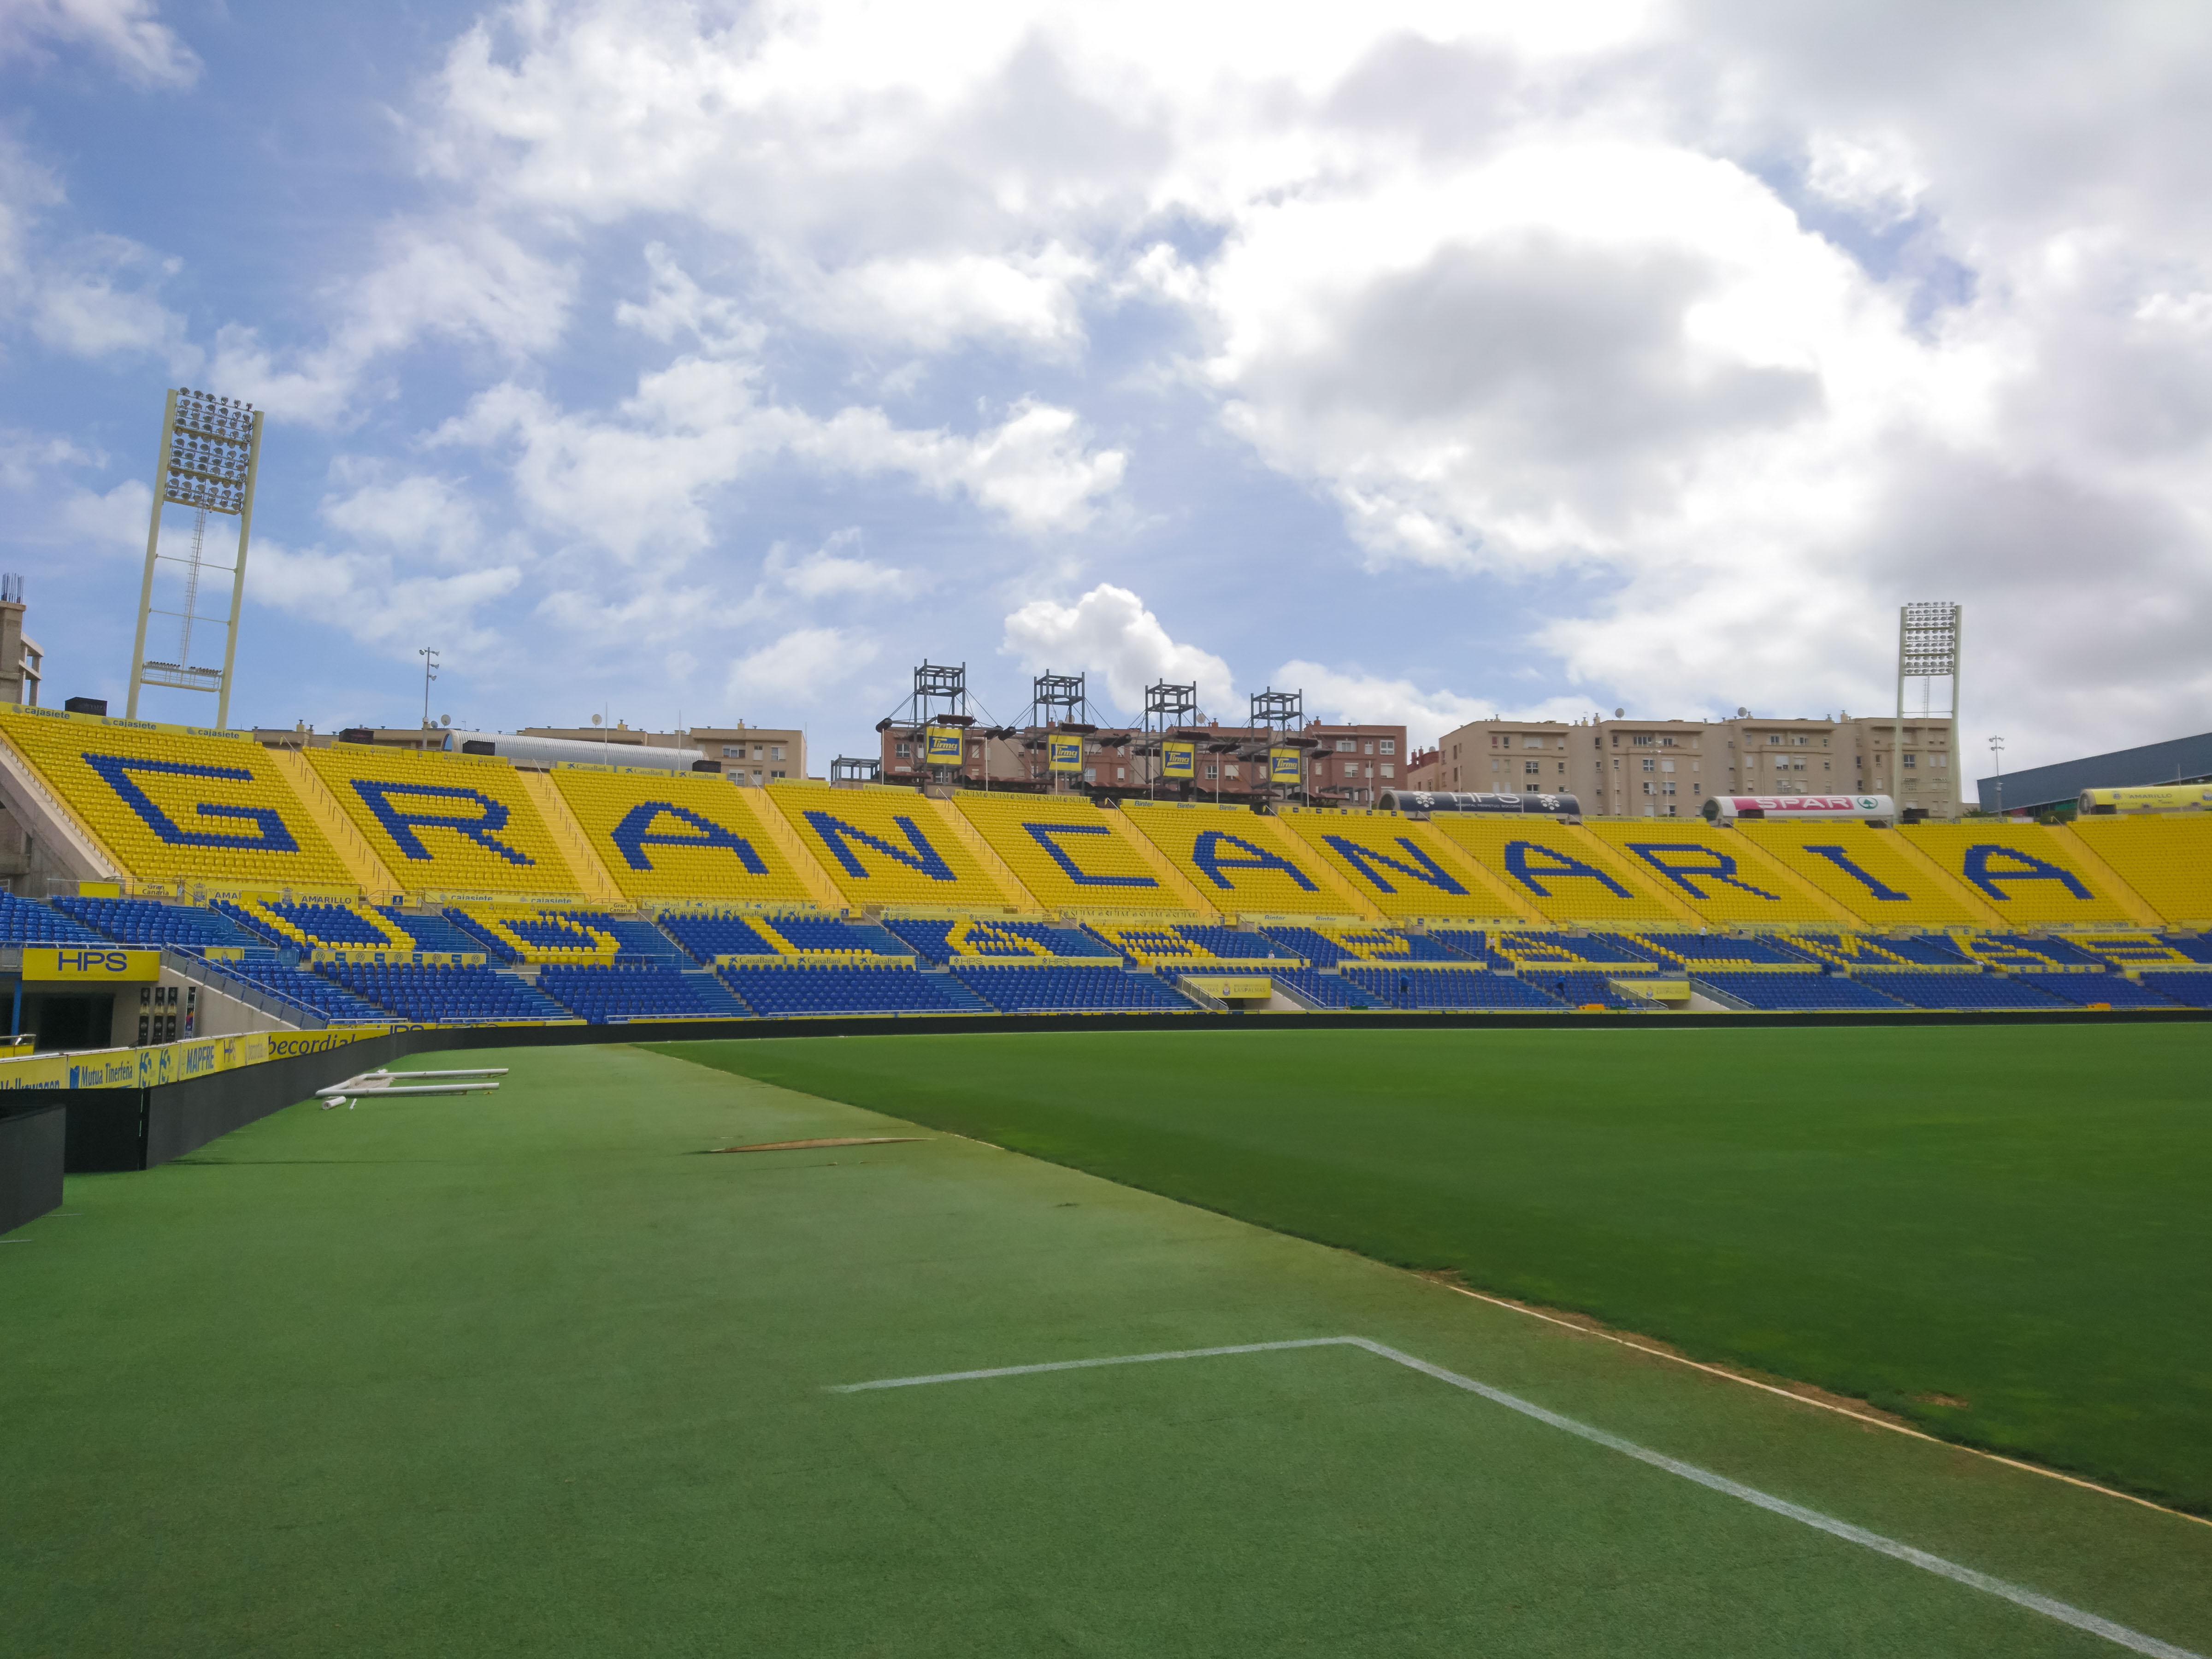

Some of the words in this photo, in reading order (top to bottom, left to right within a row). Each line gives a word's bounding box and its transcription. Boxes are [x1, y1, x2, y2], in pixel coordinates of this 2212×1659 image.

[25, 707, 70, 719] cajasiete
[113, 720, 156, 730] cajasiete
[198, 729, 239, 738] cajasiete
[932, 737, 958, 750] Tirma
[1168, 752, 1190, 763] Tirma
[1276, 758, 1298, 768] Tirma
[576, 763, 607, 772] CaixaBank
[634, 768, 664, 776] CaixaBank
[1755, 798, 1849, 809] SPAR
[80, 752, 958, 881] GRAN
[1021, 822, 2095, 901] CANARIA
[215, 891, 241, 900] AMA
[301, 896, 351, 904] AMARILLO
[58, 951, 127, 972] HPS
[186, 1045, 214, 1075] MAPFRE
[81, 1066, 103, 1088] Mutua
[105, 1061, 133, 1084] Tinerfeña
